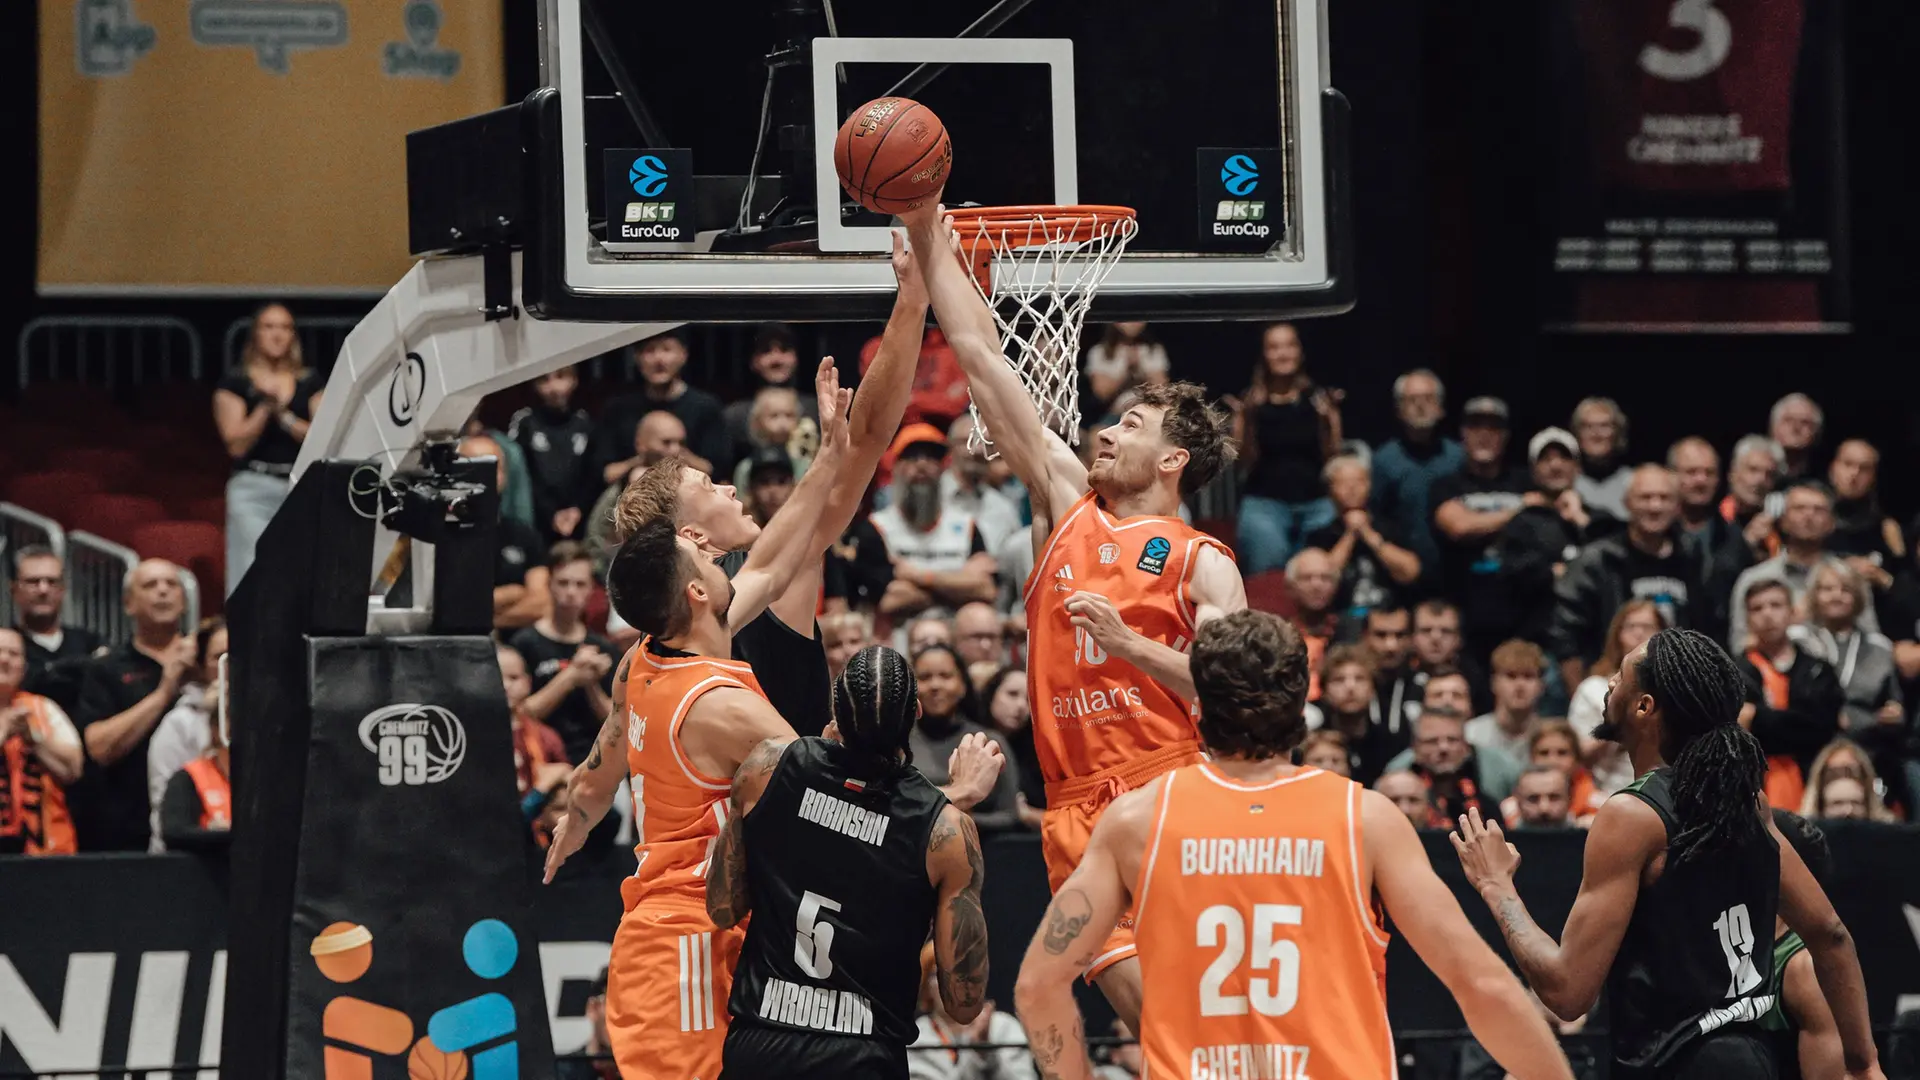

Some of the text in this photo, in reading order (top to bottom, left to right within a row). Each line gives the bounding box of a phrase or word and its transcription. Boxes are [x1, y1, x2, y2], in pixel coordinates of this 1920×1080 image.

[624, 202, 675, 222] BKT
[1216, 200, 1265, 220] BKT
[621, 224, 680, 240] EuroCup
[1212, 222, 1270, 239] EuroCup
[1138, 562, 1162, 574] EuroCup
[378, 720, 429, 736] CHEMNITZ
[378, 735, 428, 786] 99
[797, 787, 890, 847] ROBINSON
[1181, 838, 1324, 878] BURNHAM
[793, 889, 842, 980] 5
[1195, 903, 1302, 1017] 25
[759, 976, 874, 1036] WROCLAW
